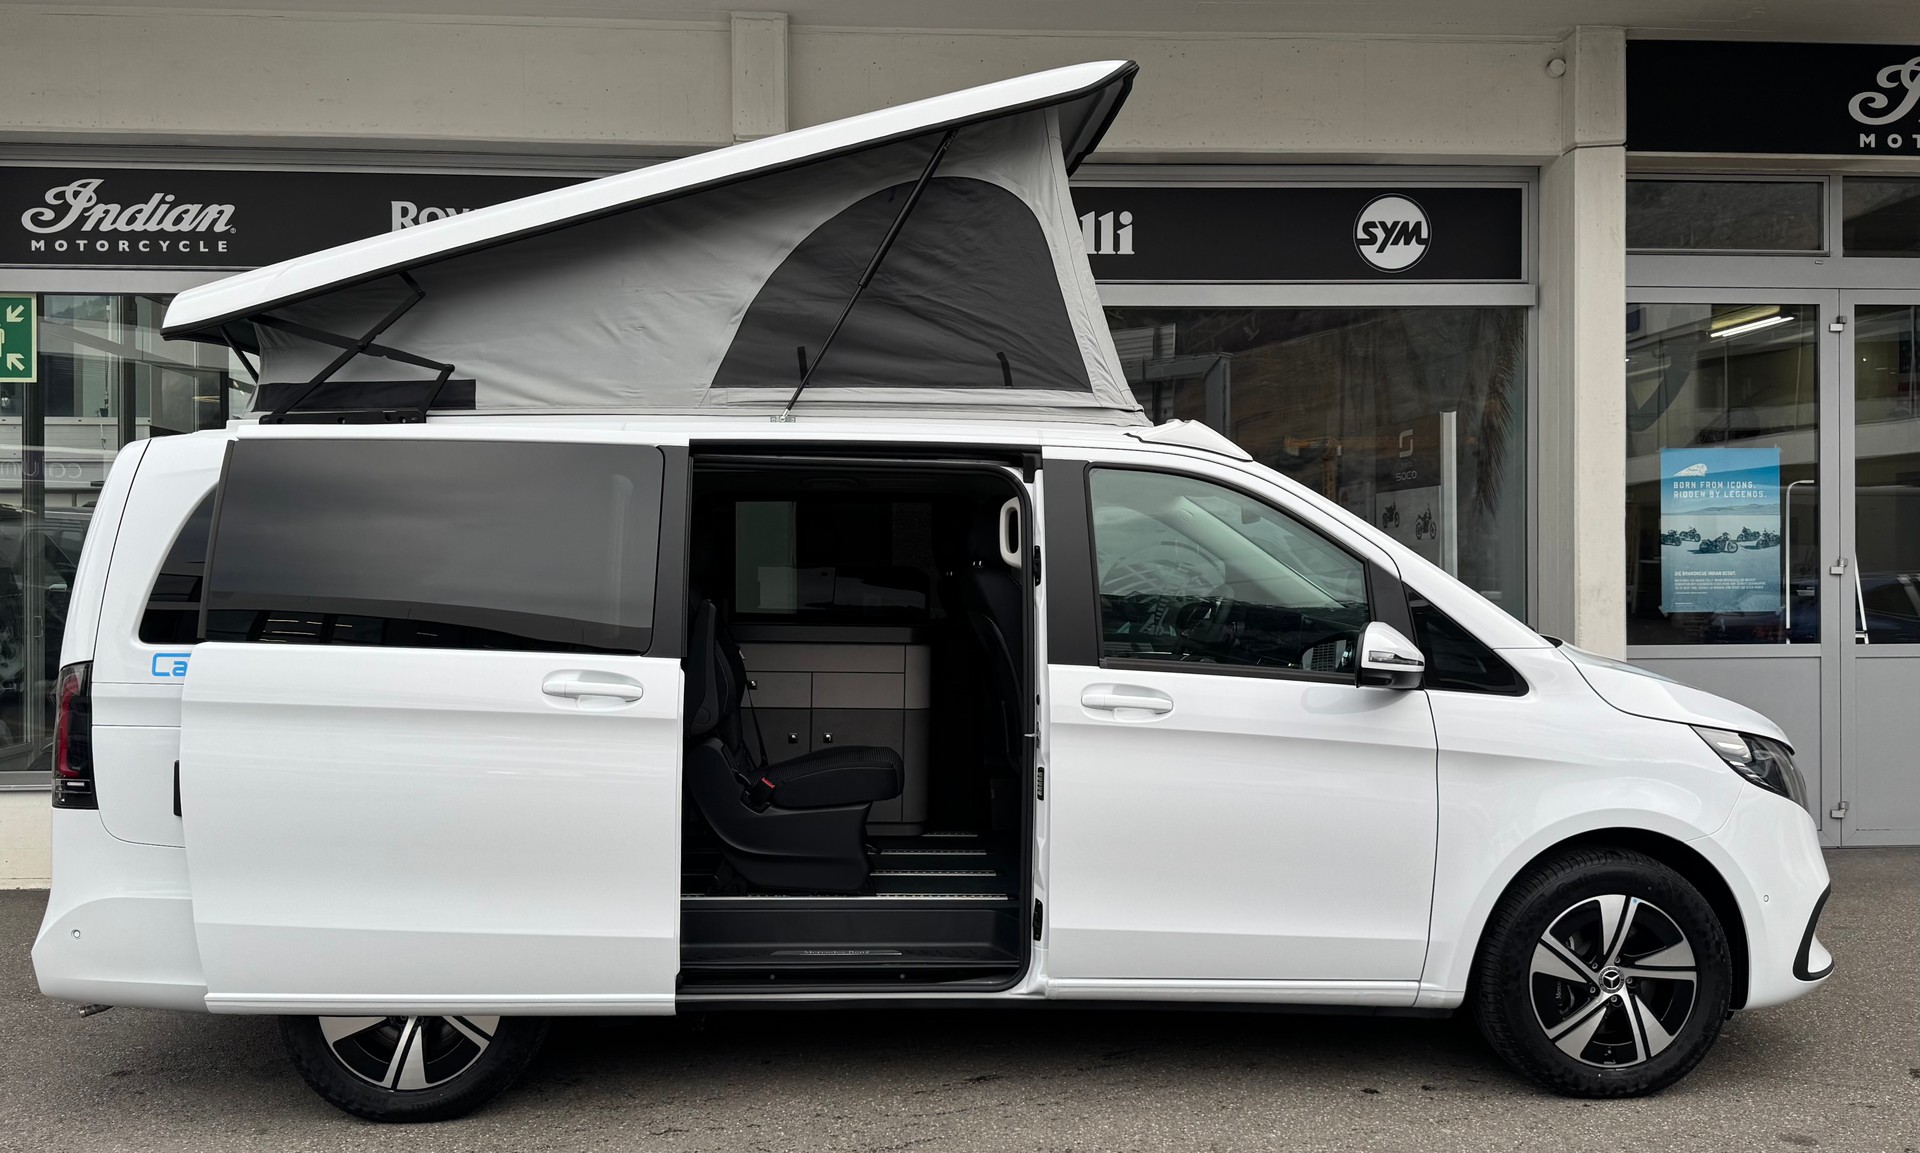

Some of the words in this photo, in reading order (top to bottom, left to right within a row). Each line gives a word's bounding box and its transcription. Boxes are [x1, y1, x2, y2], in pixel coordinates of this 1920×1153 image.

[21, 178, 236, 234] Indian
[1357, 220, 1428, 253] SYM
[31, 239, 228, 252] MOTORCYCLE
[1396, 471, 1417, 481] SOCO
[1673, 481, 1697, 489] BORN
[1700, 481, 1724, 489] FROM
[1727, 481, 1757, 489] ICONS.
[1673, 490, 1706, 498] RIDDEN
[1709, 490, 1721, 498] BY
[1724, 490, 1767, 498] LEGENDS.
[152, 653, 192, 676] Ca
